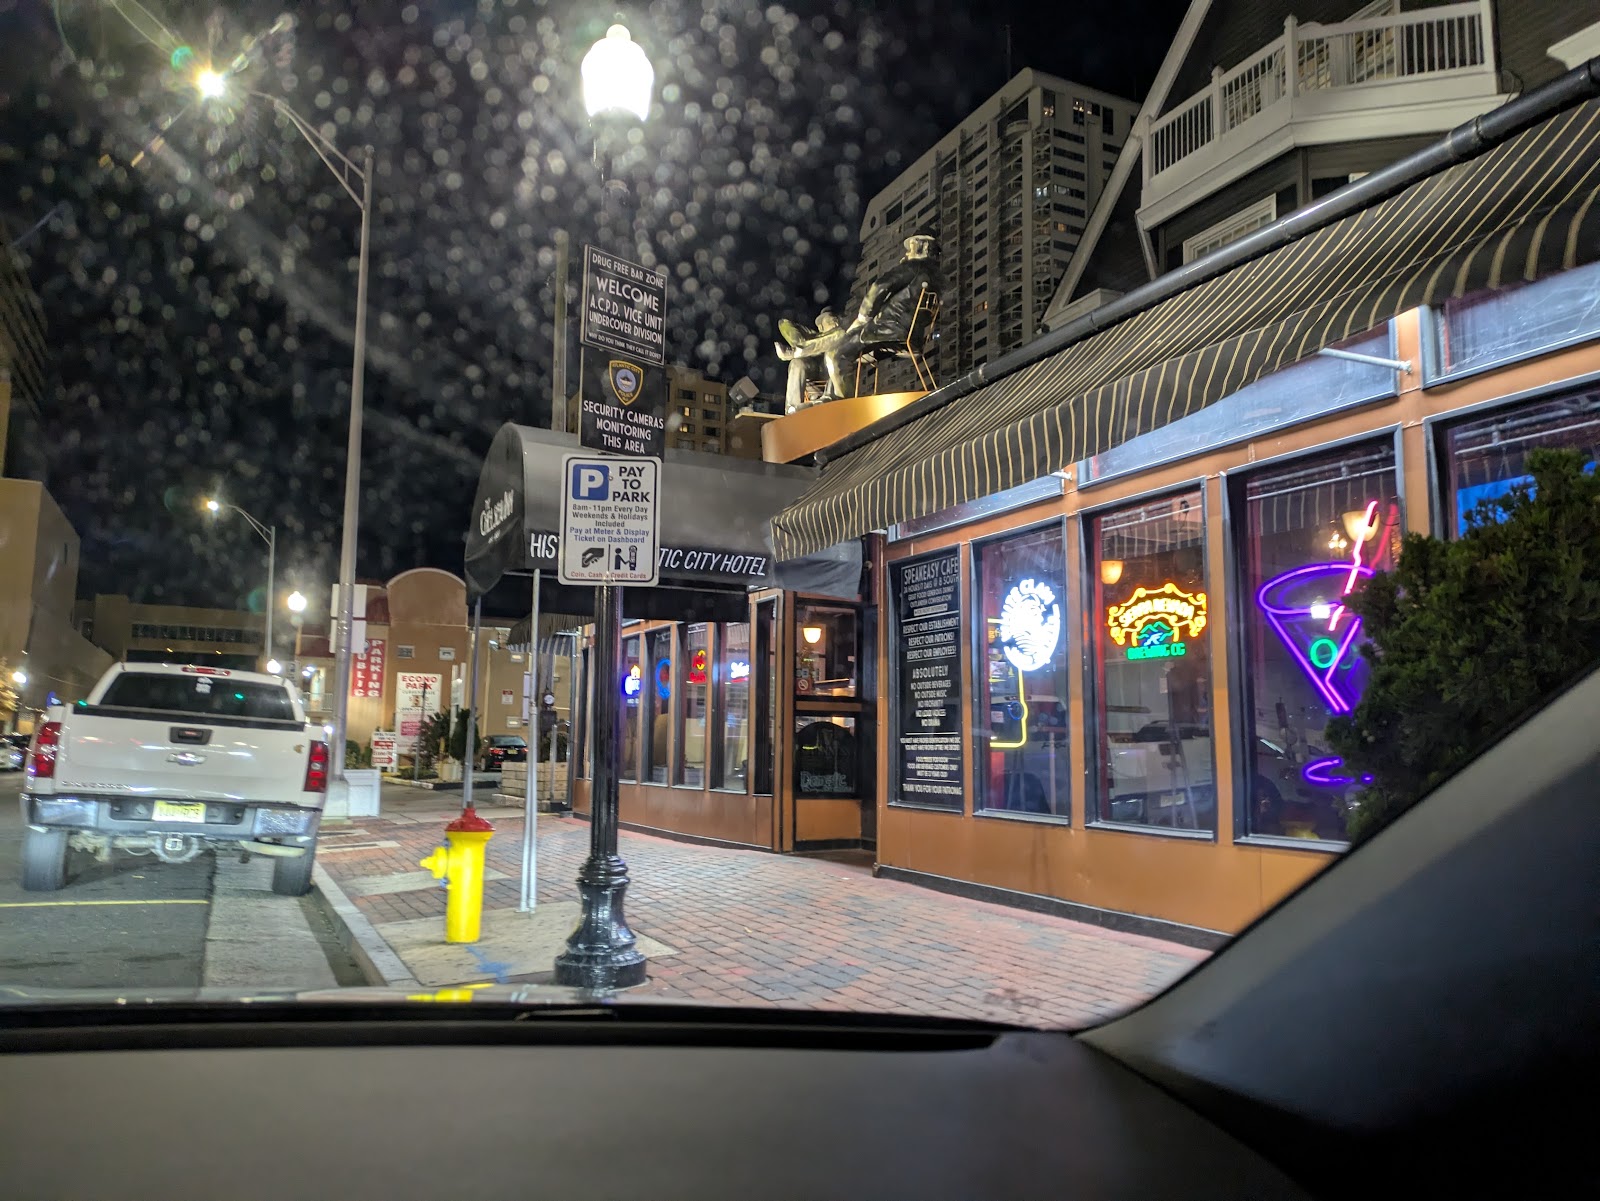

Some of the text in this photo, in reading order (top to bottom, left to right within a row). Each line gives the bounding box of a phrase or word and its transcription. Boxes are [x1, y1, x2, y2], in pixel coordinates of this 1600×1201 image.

[592, 253, 664, 288] DRUG FREE BAR ZONE
[596, 276, 659, 312] WELCOME
[590, 294, 662, 330] A.C.P.D. VICE UNIT
[589, 310, 662, 344] UNDERCOVER DIVISION
[606, 336, 614, 344] YOU
[614, 340, 626, 348] THINK
[626, 343, 635, 351] THEY
[636, 346, 644, 354] CALL
[583, 400, 664, 430] SECURITY CAMERAS
[596, 418, 652, 440] MONITORING
[602, 434, 645, 454] THIS AREA
[619, 466, 646, 477] PAY
[580, 468, 604, 497] P
[622, 479, 641, 490] TO
[612, 492, 650, 502] PARK
[614, 505, 633, 514] Every
[634, 506, 648, 514] Day
[618, 513, 648, 521] Holidays
[624, 529, 650, 537] Display
[530, 533, 560, 559] HIS
[658, 547, 683, 569] TIC
[684, 550, 721, 571] CITY
[720, 554, 766, 576] HOTEL
[904, 557, 958, 585] SPEAKEASY CAFE
[943, 574, 959, 585] SOUTH
[903, 624, 919, 634] RESPECT
[919, 622, 928, 631] OUR
[909, 636, 924, 646] RESPECT
[925, 634, 934, 644] OUR
[907, 650, 922, 660] RESPECT
[923, 648, 932, 658] OUR
[354, 653, 367, 697] UBLIC
[367, 640, 384, 697] PARKING
[912, 665, 948, 679] ABSOLUTELY
[916, 681, 931, 690] OUTSIDE
[932, 680, 951, 688] BEVERAGES
[921, 690, 936, 698] OUTSIDE
